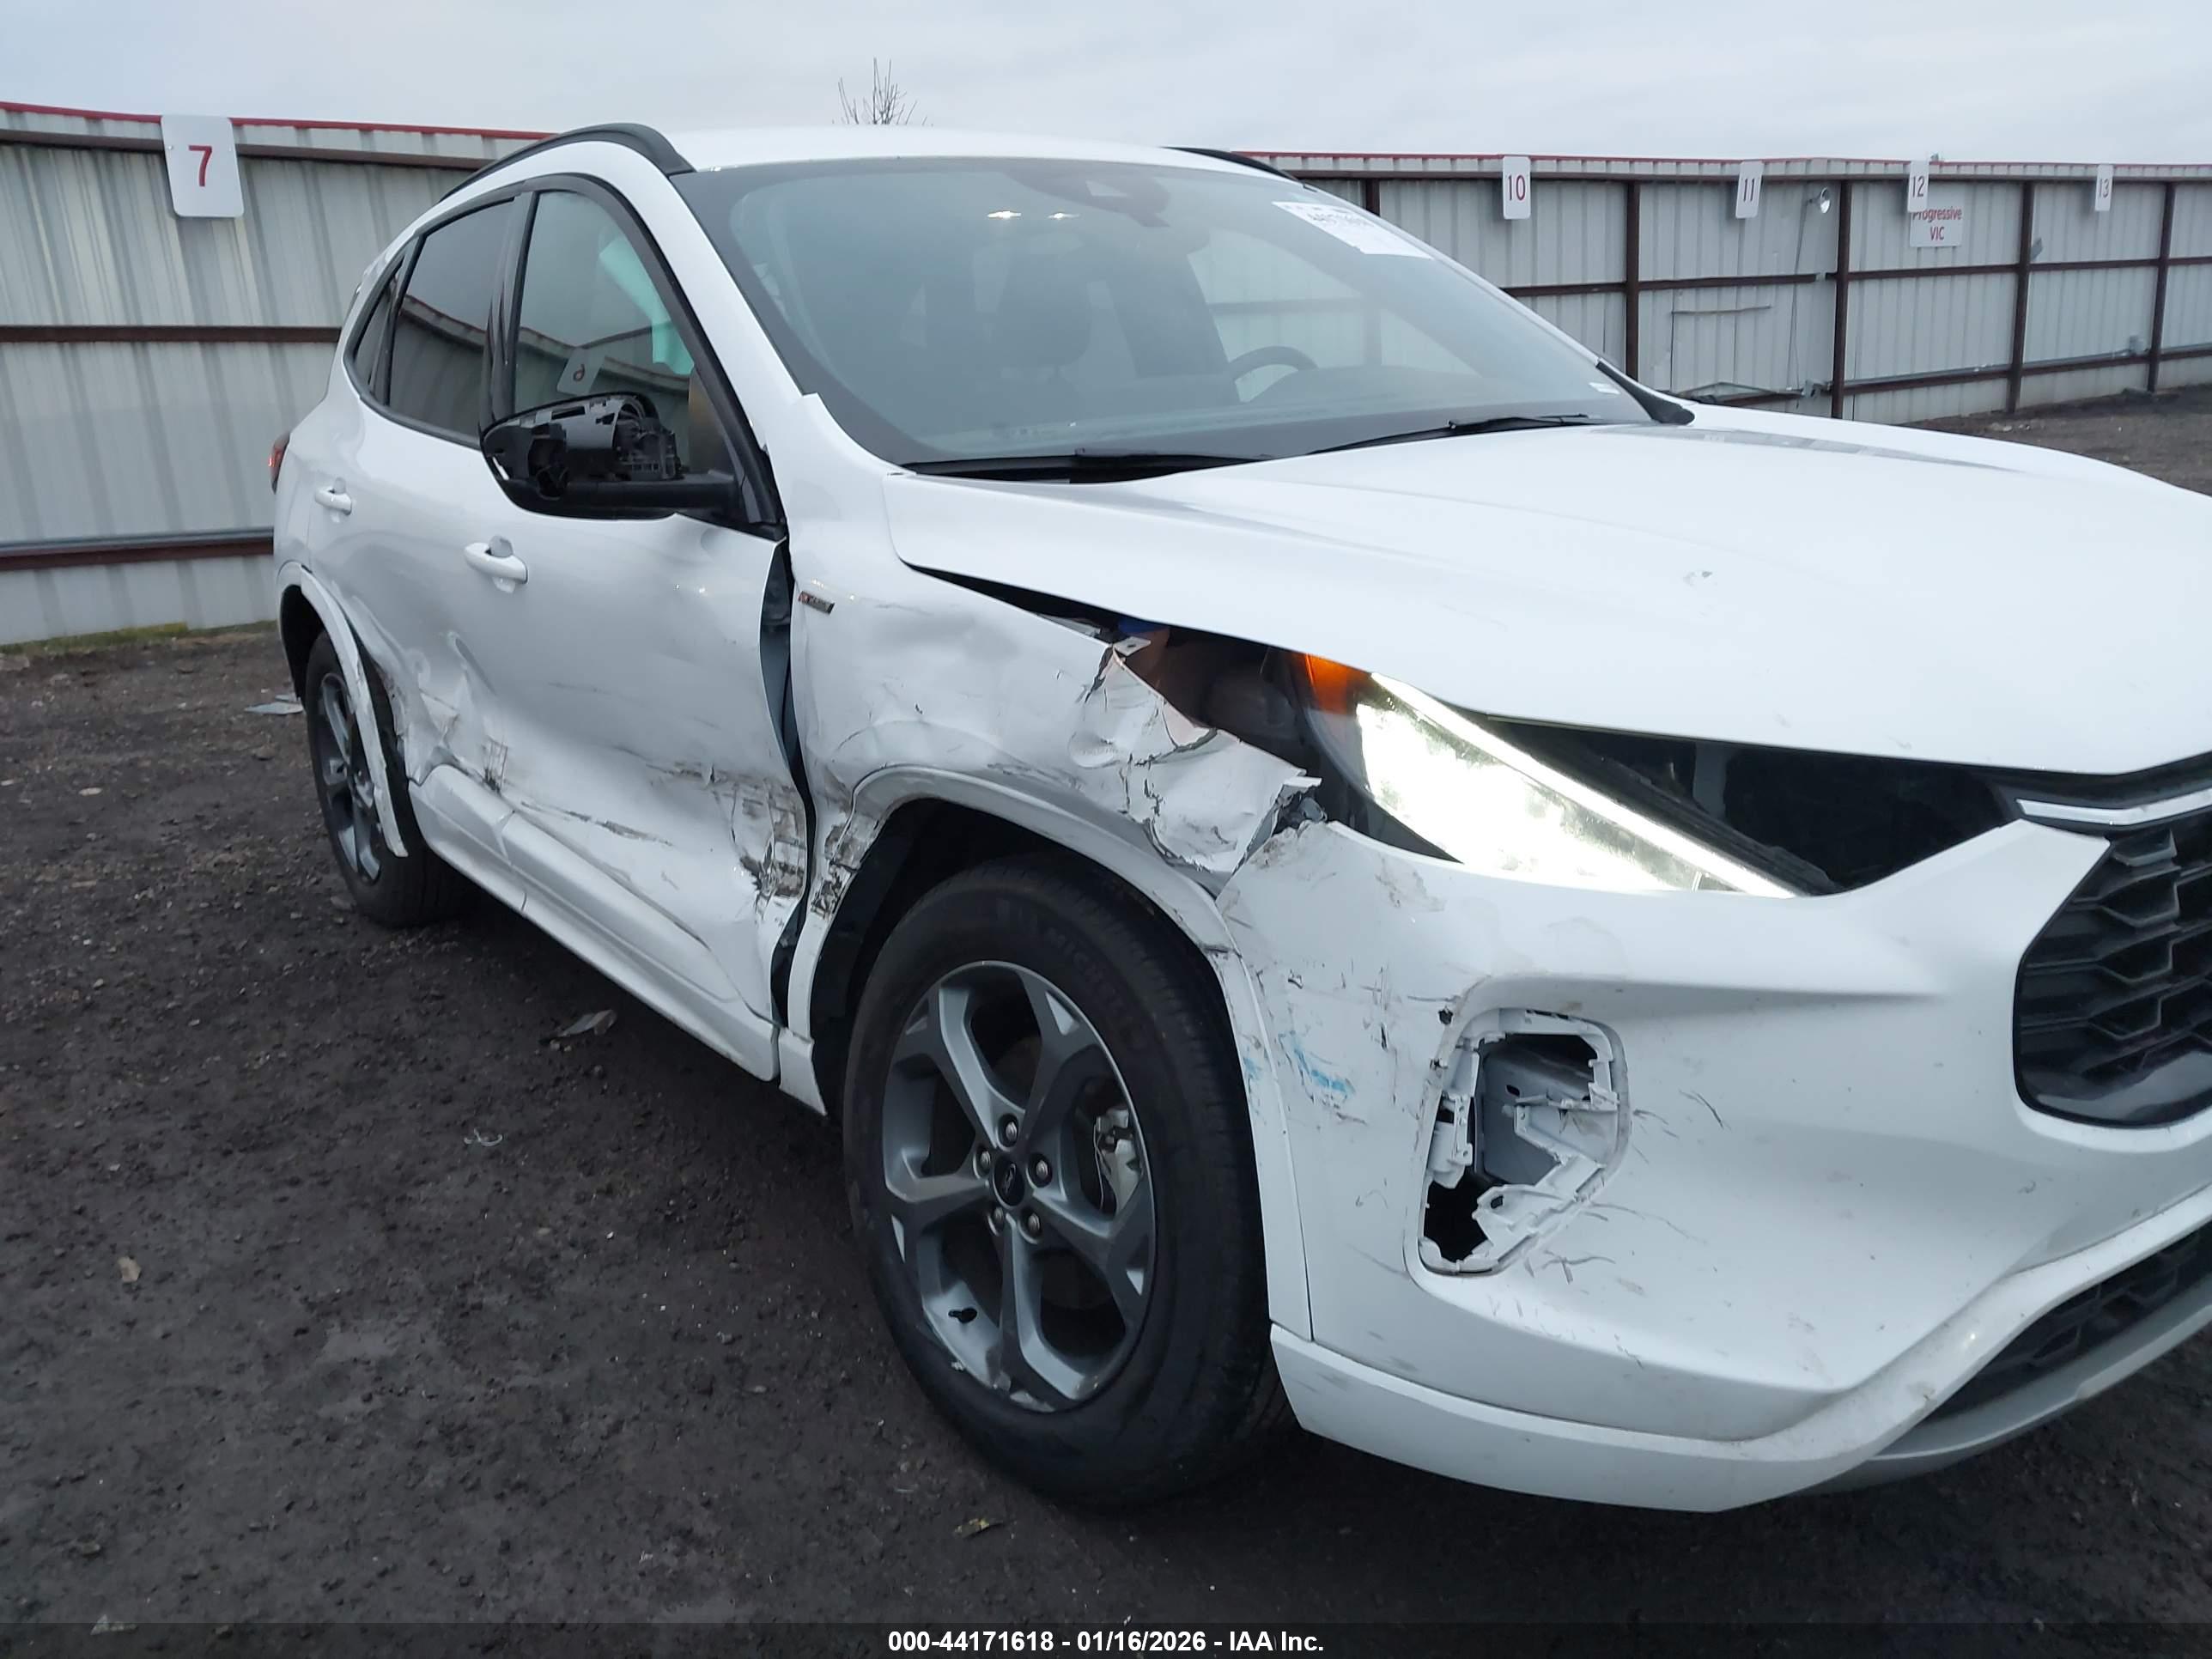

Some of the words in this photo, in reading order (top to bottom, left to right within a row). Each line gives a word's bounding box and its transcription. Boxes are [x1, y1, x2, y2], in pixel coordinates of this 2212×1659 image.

[188, 144, 213, 187] 7
[1508, 174, 1526, 201] 10
[1743, 178, 1755, 202] 11
[1912, 175, 1925, 198] 12
[2099, 178, 2110, 198] 13
[1929, 226, 1945, 240] VIC
